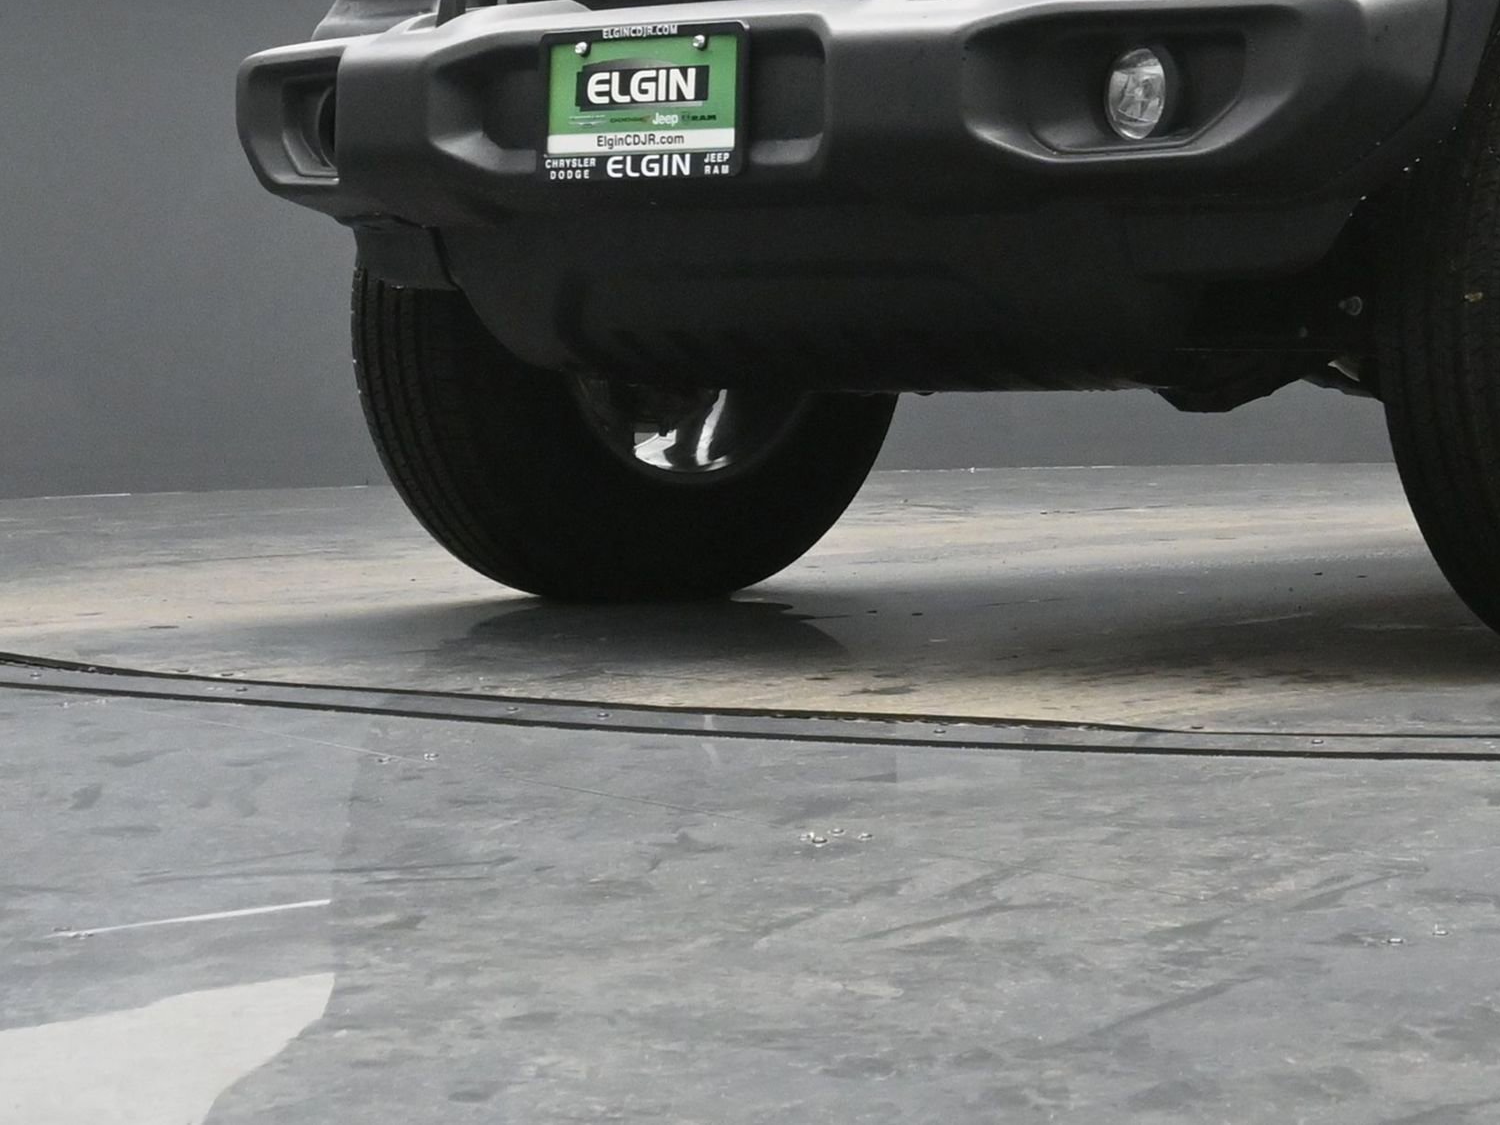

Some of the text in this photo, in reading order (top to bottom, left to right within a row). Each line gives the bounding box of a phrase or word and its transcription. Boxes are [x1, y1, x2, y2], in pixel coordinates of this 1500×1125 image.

[602, 24, 678, 39] ELGINCDJR.COM
[587, 67, 696, 104] ELGIN
[652, 112, 678, 127] Jeep
[596, 133, 685, 149] ElginCDJR.com
[545, 157, 596, 169] CHRYSLER
[704, 153, 730, 163] JEEP
[606, 154, 690, 178] ELGIN
[704, 165, 730, 176] RAM
[550, 169, 590, 180] DODGE
